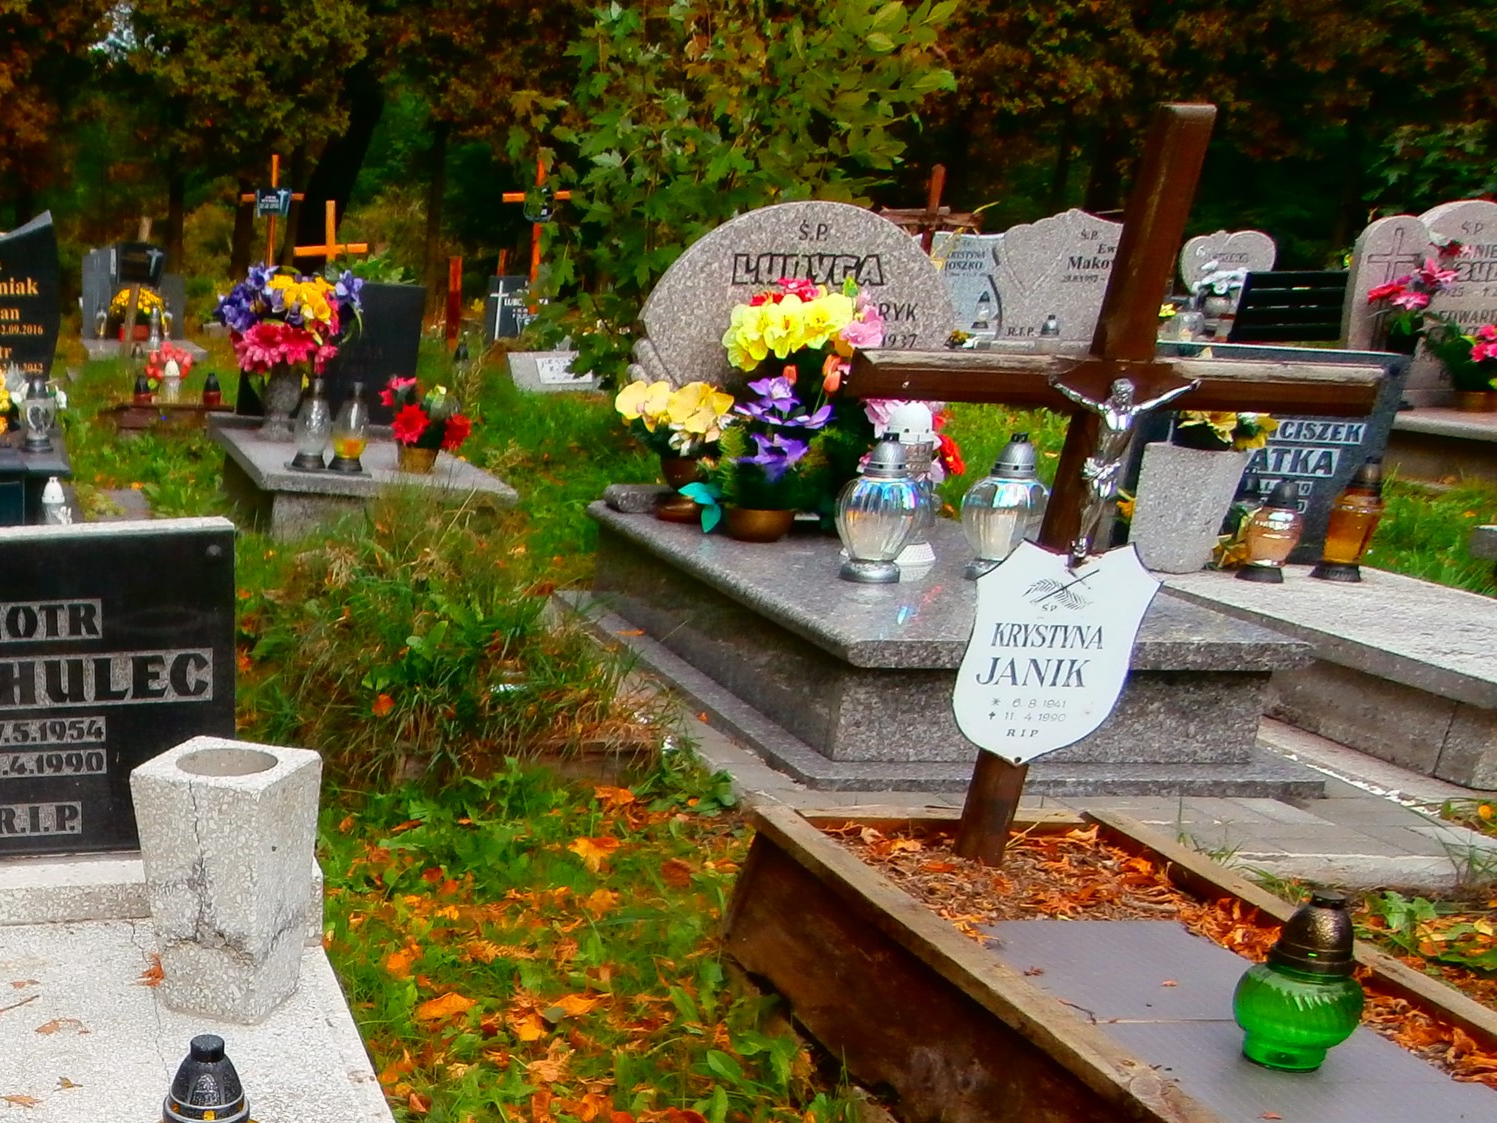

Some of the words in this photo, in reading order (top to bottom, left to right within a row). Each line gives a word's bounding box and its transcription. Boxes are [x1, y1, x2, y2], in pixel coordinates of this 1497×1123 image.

[1067, 256, 1112, 270] Mako
[1252, 449, 1334, 475] ATKA
[990, 623, 1104, 650] KRYSTYNA
[976, 656, 1091, 688] JANIK
